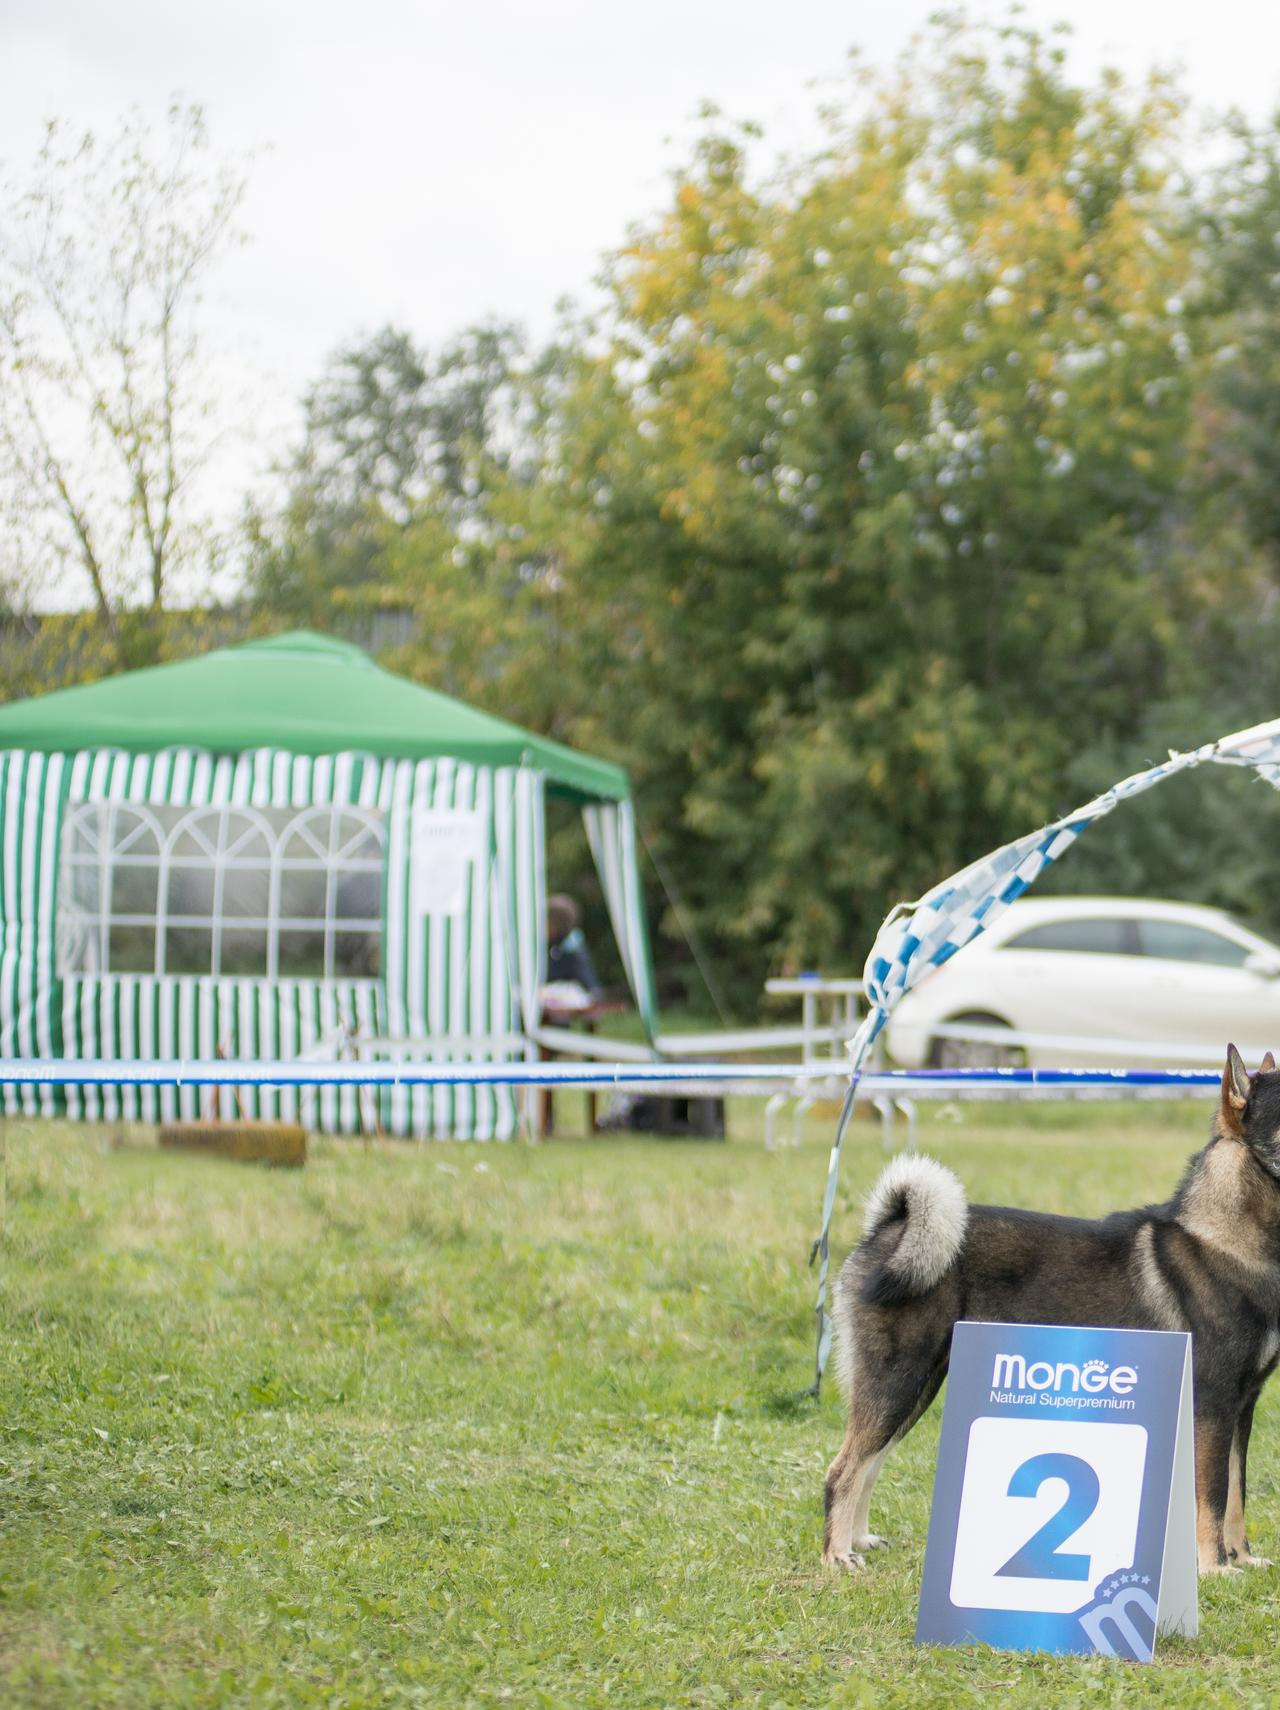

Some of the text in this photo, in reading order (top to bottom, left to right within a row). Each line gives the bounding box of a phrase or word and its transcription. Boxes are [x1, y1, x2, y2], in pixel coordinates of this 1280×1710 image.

[989, 1390, 1136, 1410] Natural Superpremium
[993, 1452, 1101, 1582] 2
